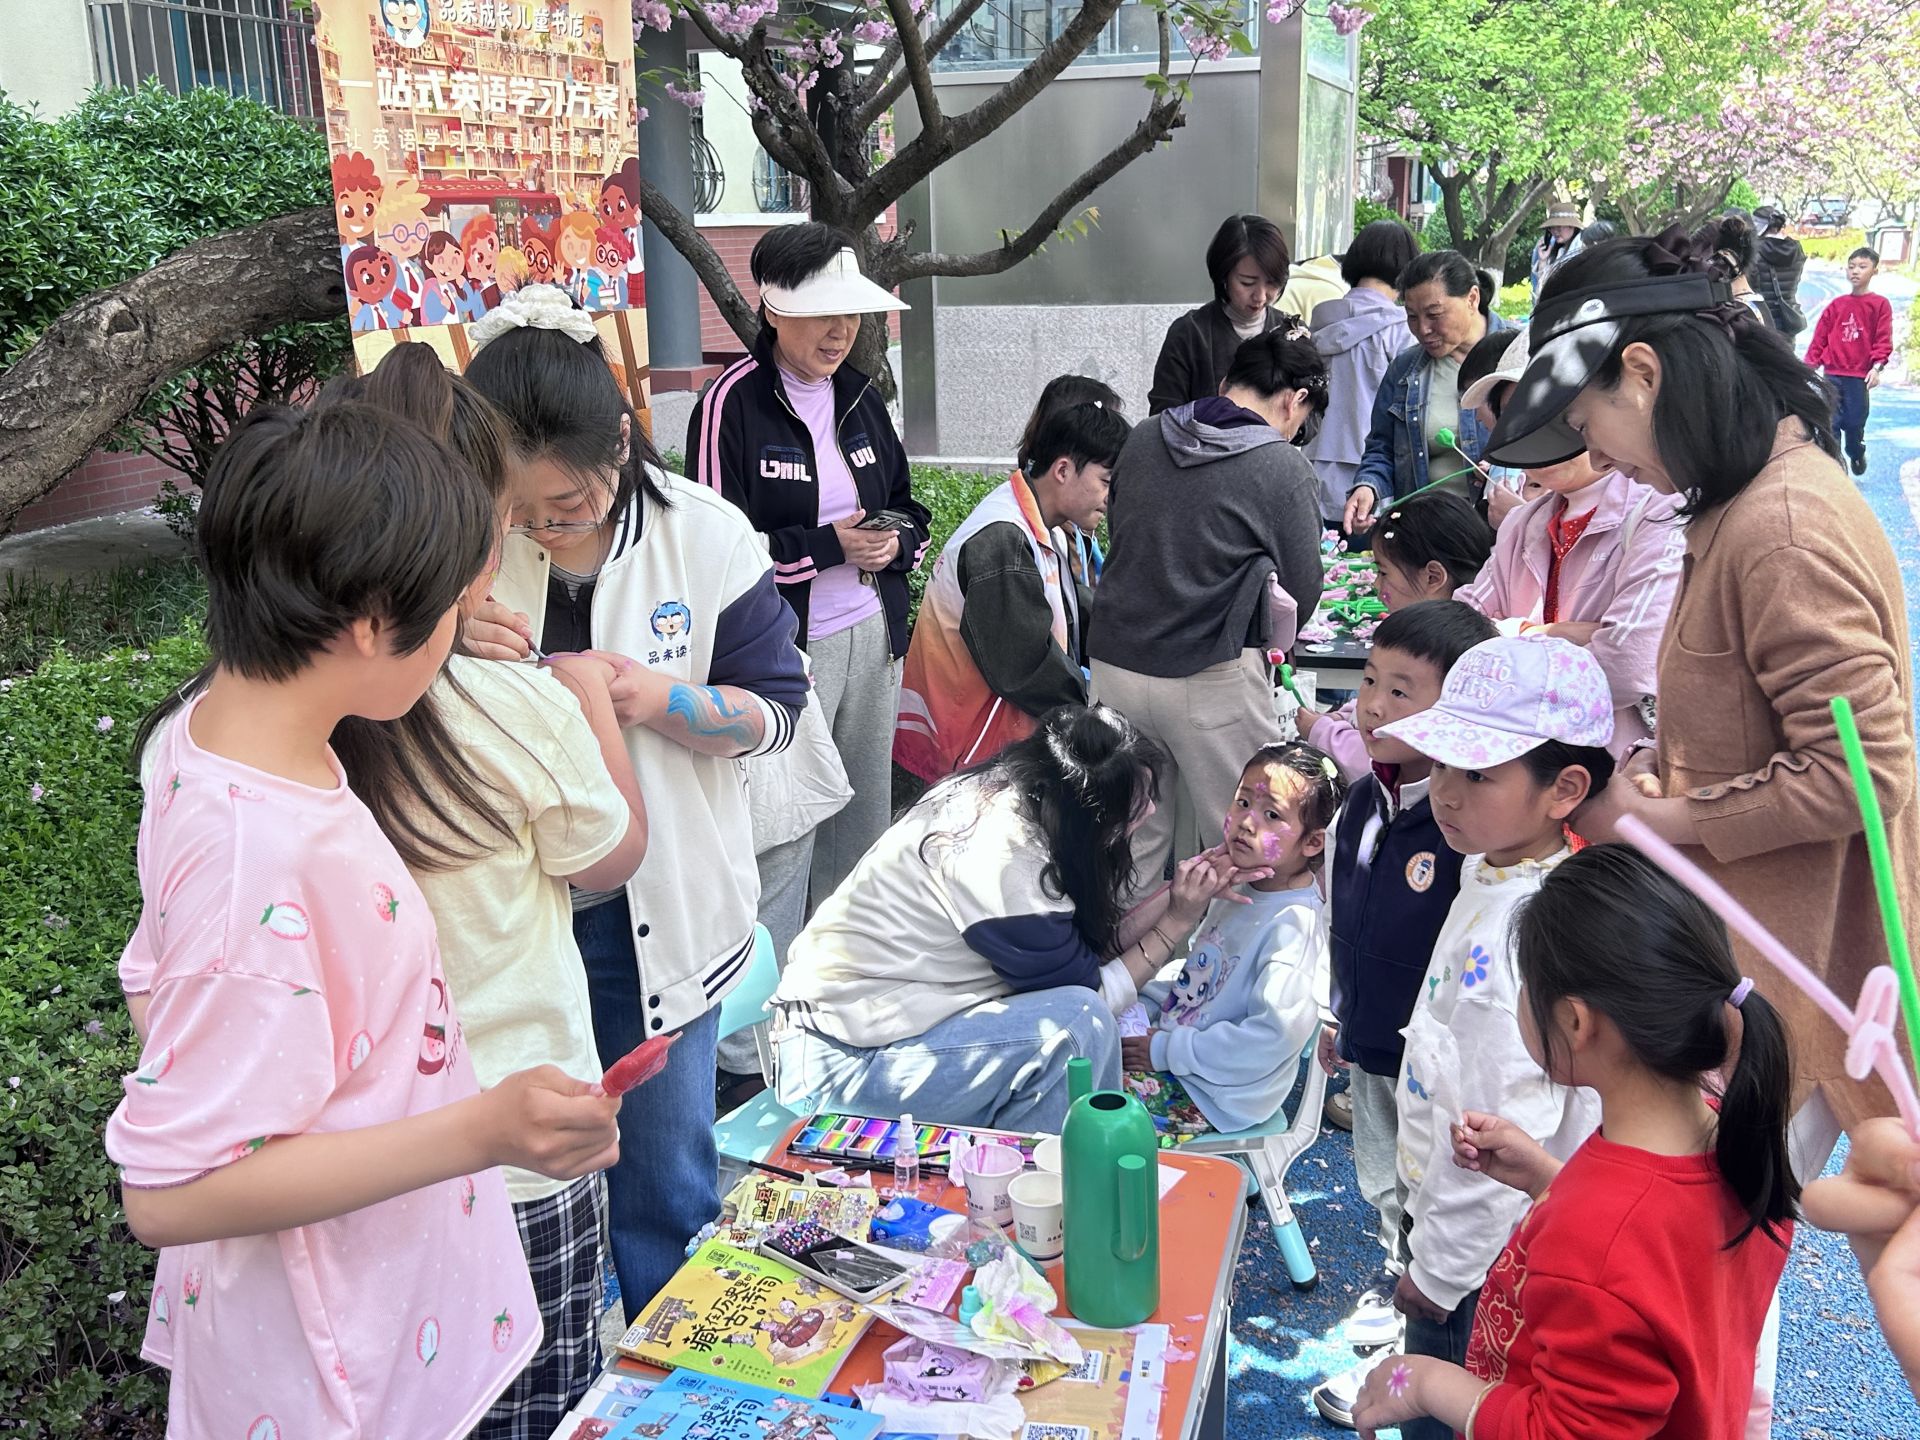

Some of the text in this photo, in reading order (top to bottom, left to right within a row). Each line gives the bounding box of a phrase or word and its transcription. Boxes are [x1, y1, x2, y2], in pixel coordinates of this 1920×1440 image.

[338, 67, 619, 121] 一站式英语学习方案
[345, 127, 621, 158] 让英语学习变得更加有趣高效
[682, 1271, 757, 1353] 藏在历史里的
